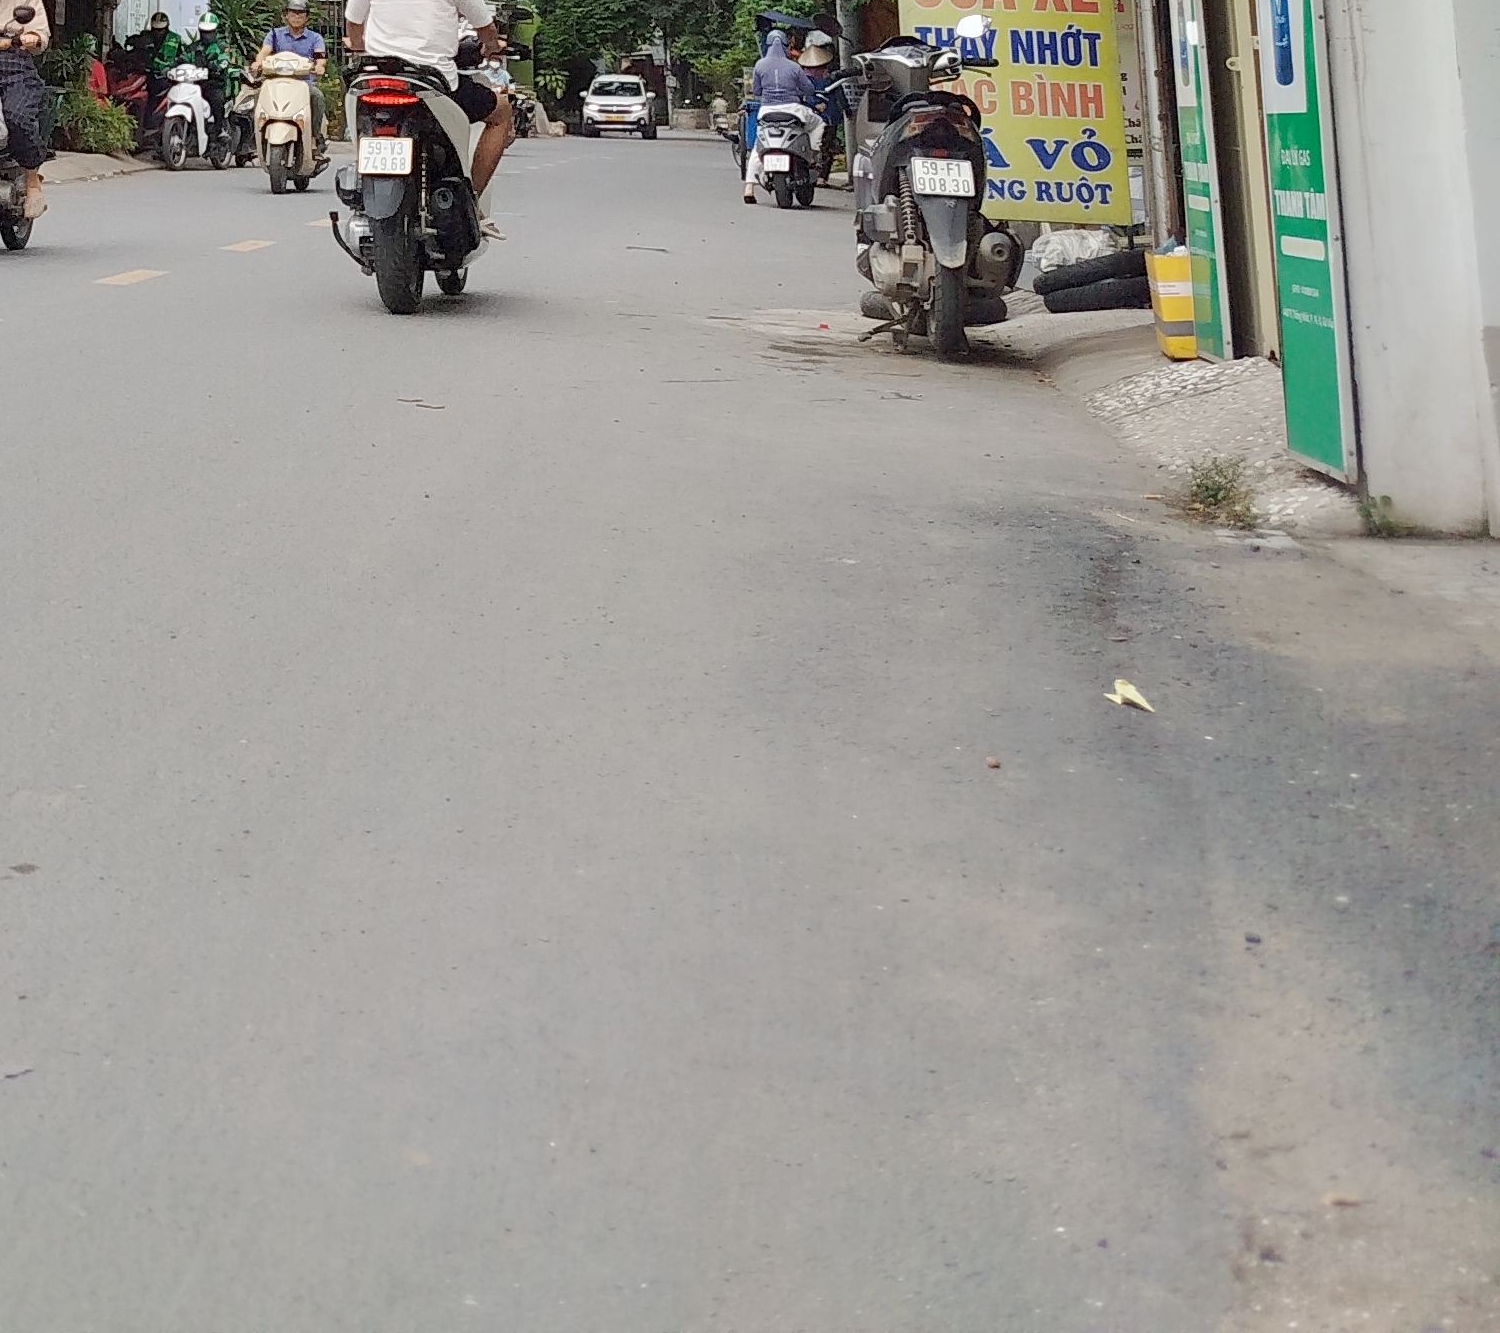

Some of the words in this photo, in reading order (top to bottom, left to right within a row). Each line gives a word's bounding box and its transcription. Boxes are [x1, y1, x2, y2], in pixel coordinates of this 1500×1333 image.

[1011, 24, 1102, 67] NHỚT
[1011, 73, 1104, 119] BÌNH
[367, 141, 403, 156] 59-V3
[1025, 127, 1112, 172] VỎ
[363, 156, 406, 171] 749.68
[921, 161, 961, 177] 59-F1
[917, 176, 971, 194] 908.30
[1035, 176, 1113, 210] RUỘT
